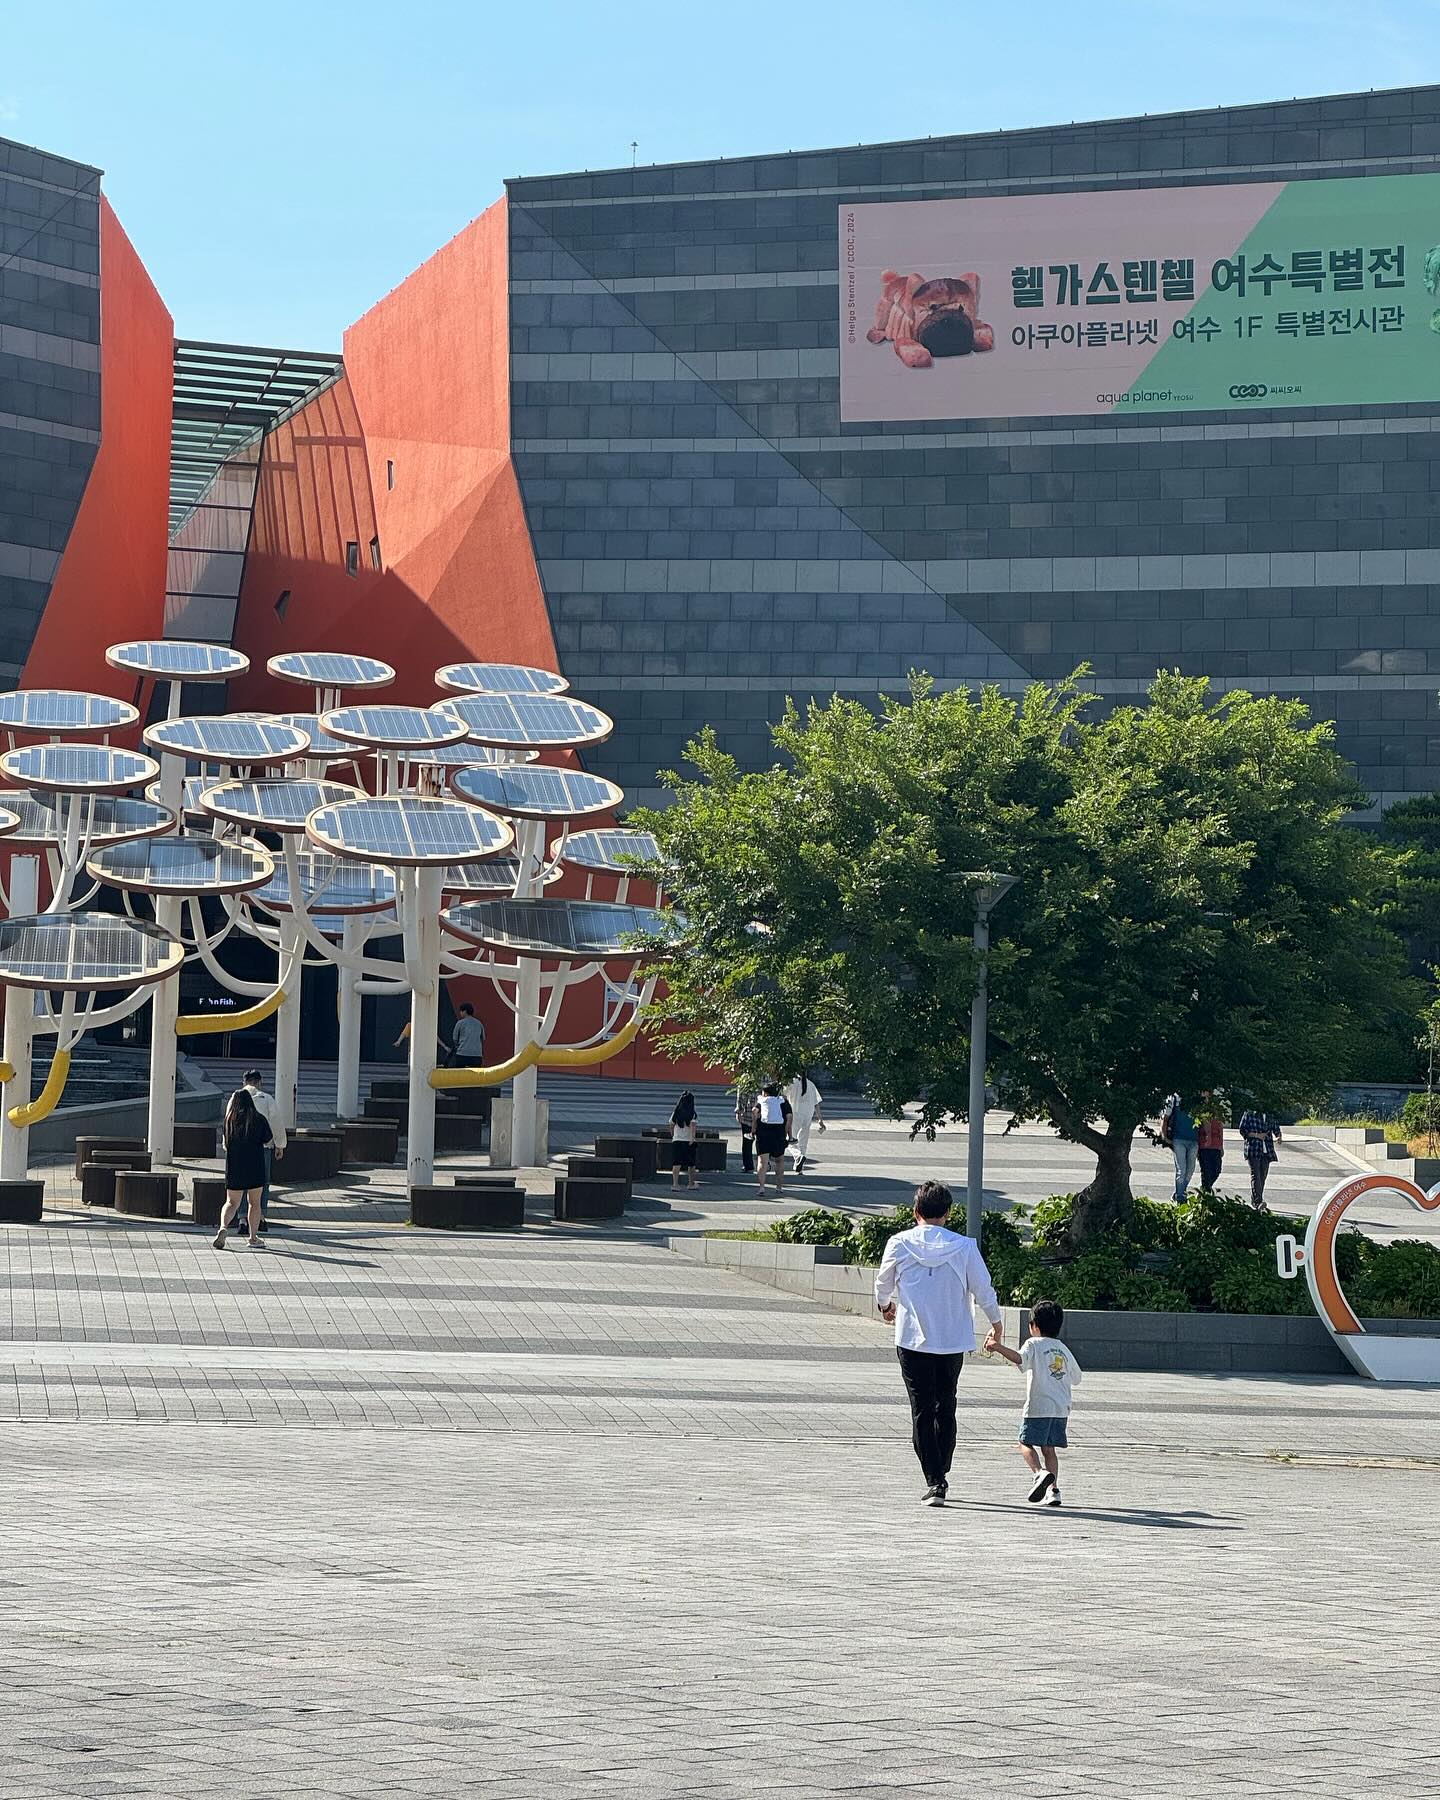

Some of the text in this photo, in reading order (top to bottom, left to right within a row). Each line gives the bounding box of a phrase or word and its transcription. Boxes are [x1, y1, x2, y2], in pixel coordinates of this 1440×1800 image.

[847, 213, 855, 232] 2024
[847, 271, 855, 307] Stentzel
[1011, 246, 1406, 308] 헬가스텐첼 여수특별전
[1011, 306, 1405, 349] 아쿠아플라넷 여수 1F 특별전시관
[1096, 392, 1130, 405] aqua
[1132, 389, 1172, 404] planet
[1325, 1189, 1353, 1225] 아쿠아플라넷
